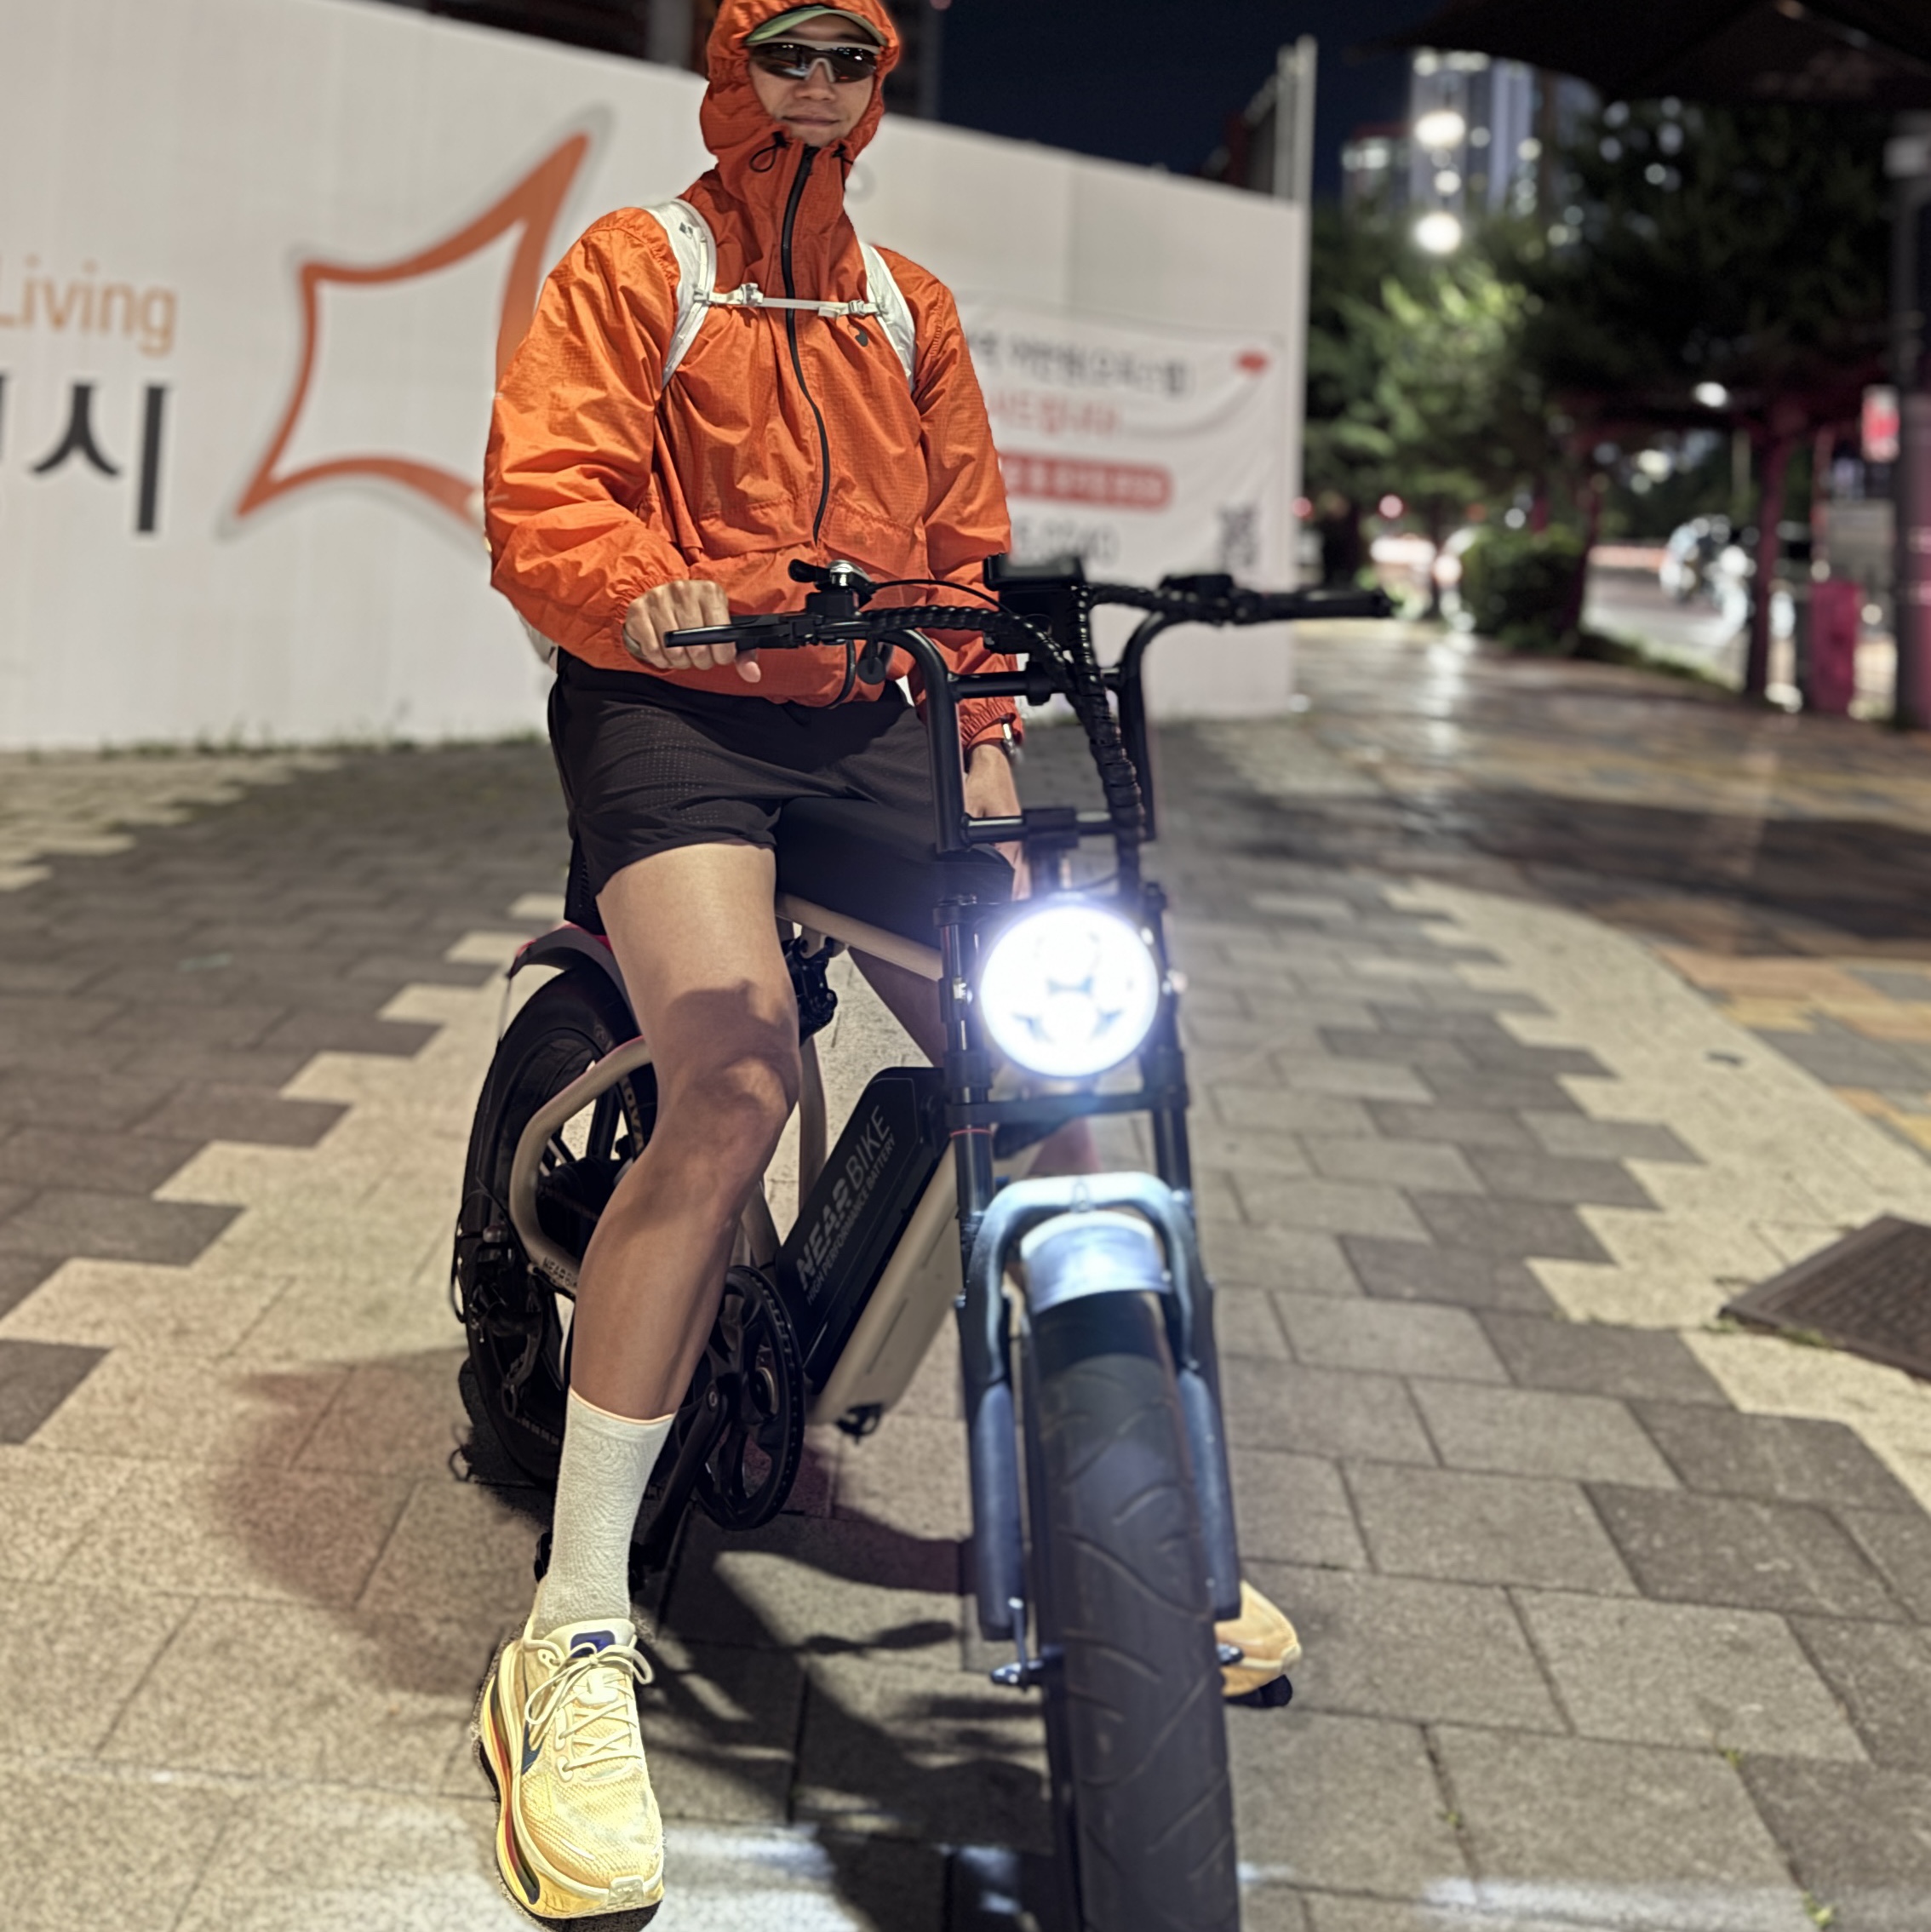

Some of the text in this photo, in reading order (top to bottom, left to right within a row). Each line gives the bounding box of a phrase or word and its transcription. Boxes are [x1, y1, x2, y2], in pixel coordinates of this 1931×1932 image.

[806, 1133, 896, 1306] HIGH PERFORMANCE BATTERY
